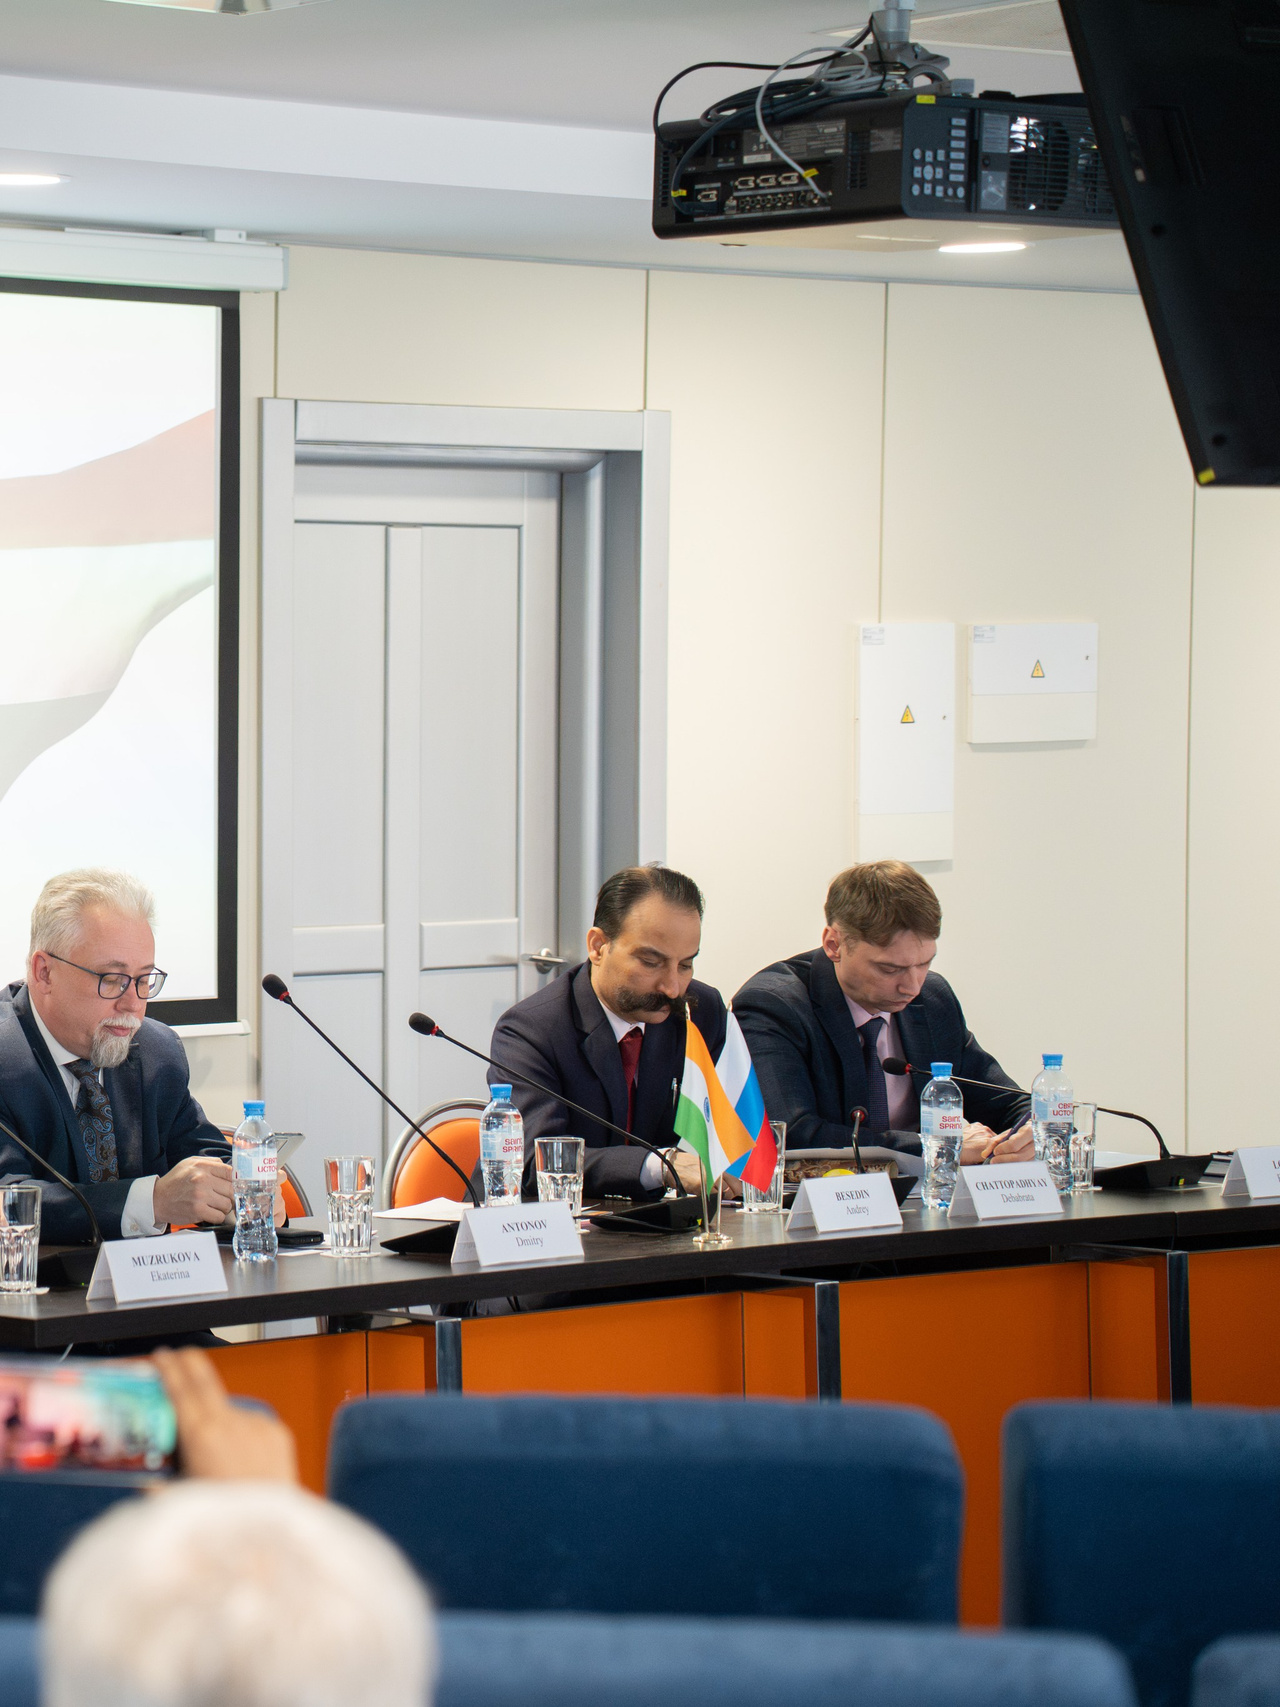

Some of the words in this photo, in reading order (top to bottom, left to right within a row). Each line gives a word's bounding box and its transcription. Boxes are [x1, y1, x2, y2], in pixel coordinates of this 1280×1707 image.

[975, 1178, 1048, 1191] CHATTOPADHYAY
[835, 1189, 870, 1201] BESEDIN
[846, 1204, 869, 1216] Andrey
[502, 1219, 548, 1233] ANTONOV
[516, 1235, 544, 1247] Dmitry
[131, 1251, 200, 1267] MUZRUKOVA
[150, 1268, 190, 1282] Ekaterina
